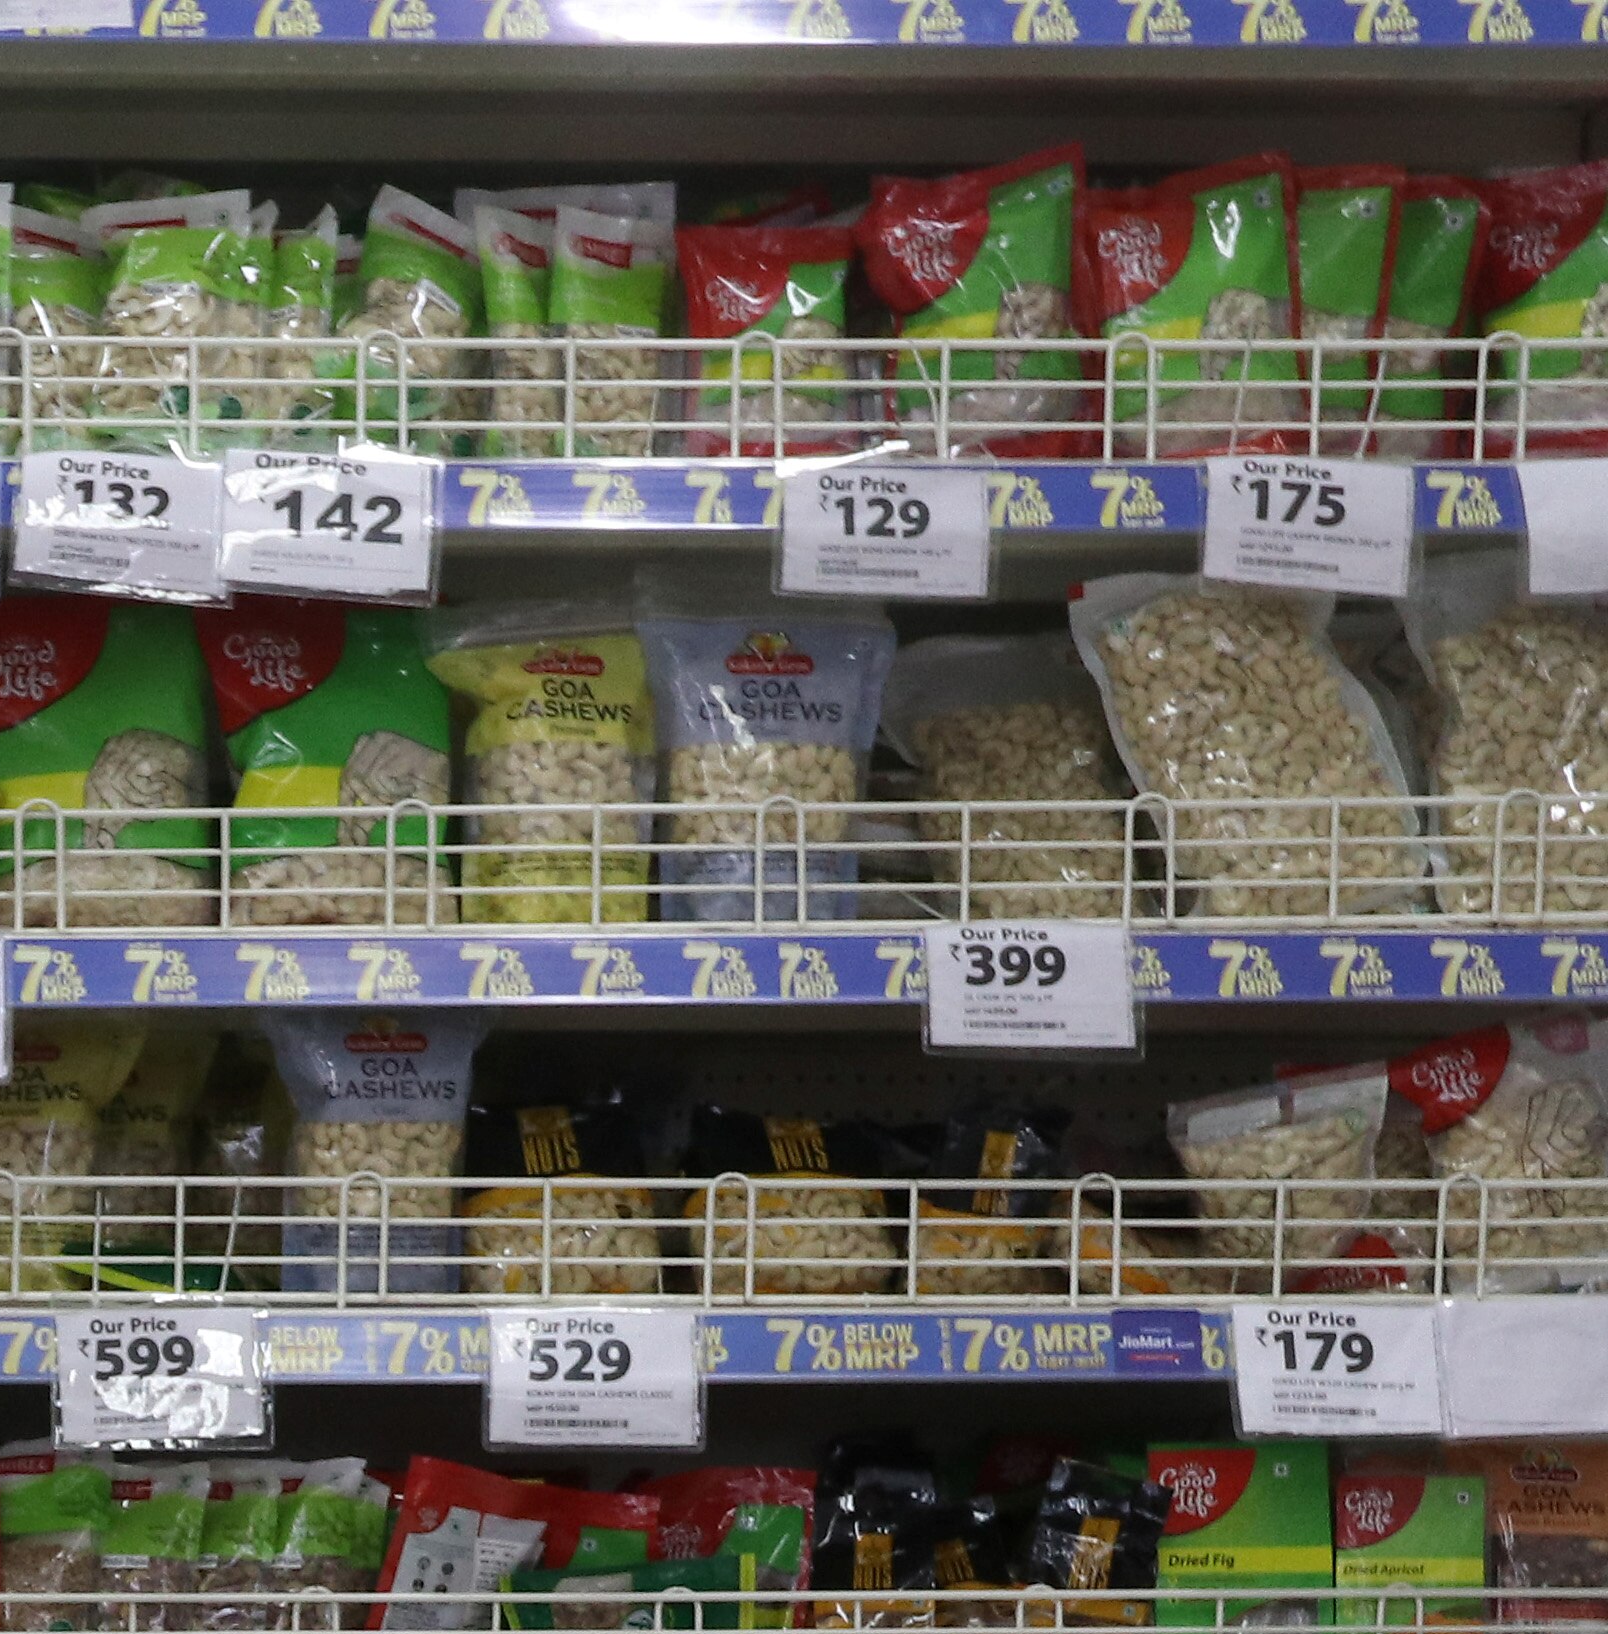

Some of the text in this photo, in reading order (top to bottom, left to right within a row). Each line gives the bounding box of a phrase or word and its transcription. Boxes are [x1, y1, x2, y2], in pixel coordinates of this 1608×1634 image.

[59, 459, 151, 483] Our Price
[255, 454, 297, 470] Our
[1243, 461, 1333, 482] Our Price
[820, 476, 907, 494] Our Price
[541, 678, 595, 700] GOA
[741, 679, 801, 700] GOA
[506, 701, 633, 725] CASHEWS
[961, 926, 1048, 942] Our Price
[361, 1057, 418, 1079] GOA
[325, 1079, 457, 1101] CASHEWS
[526, 1146, 581, 1175] NUTS
[90, 1317, 177, 1334] Our Price
[527, 1317, 615, 1336] Our Price
[1267, 1311, 1357, 1329] Our Price
[956, 1317, 1112, 1372] 7% MRP
[1167, 1552, 1235, 1573] Dried Fig
[1343, 1563, 1425, 1578] Dried Apricot
